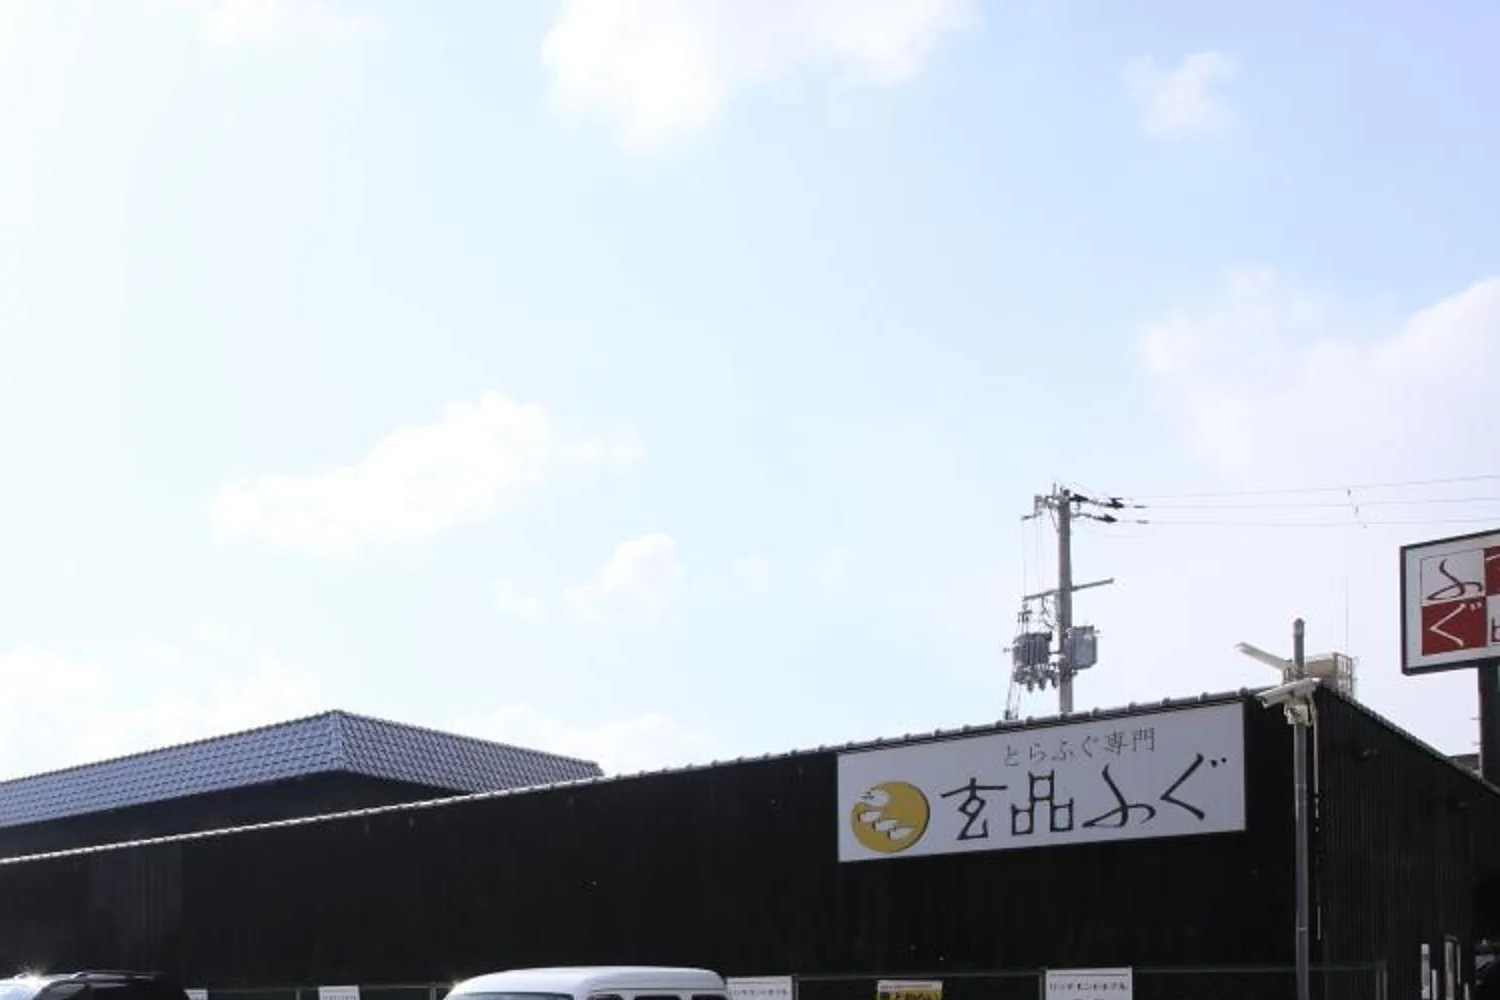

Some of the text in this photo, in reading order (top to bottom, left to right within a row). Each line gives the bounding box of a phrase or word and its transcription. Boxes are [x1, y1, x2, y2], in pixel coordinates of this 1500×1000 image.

[1426, 558, 1483, 647] ふぐ
[1003, 727, 1157, 768] とらふぐ専門
[940, 753, 1227, 840] 玄品ふぐ
